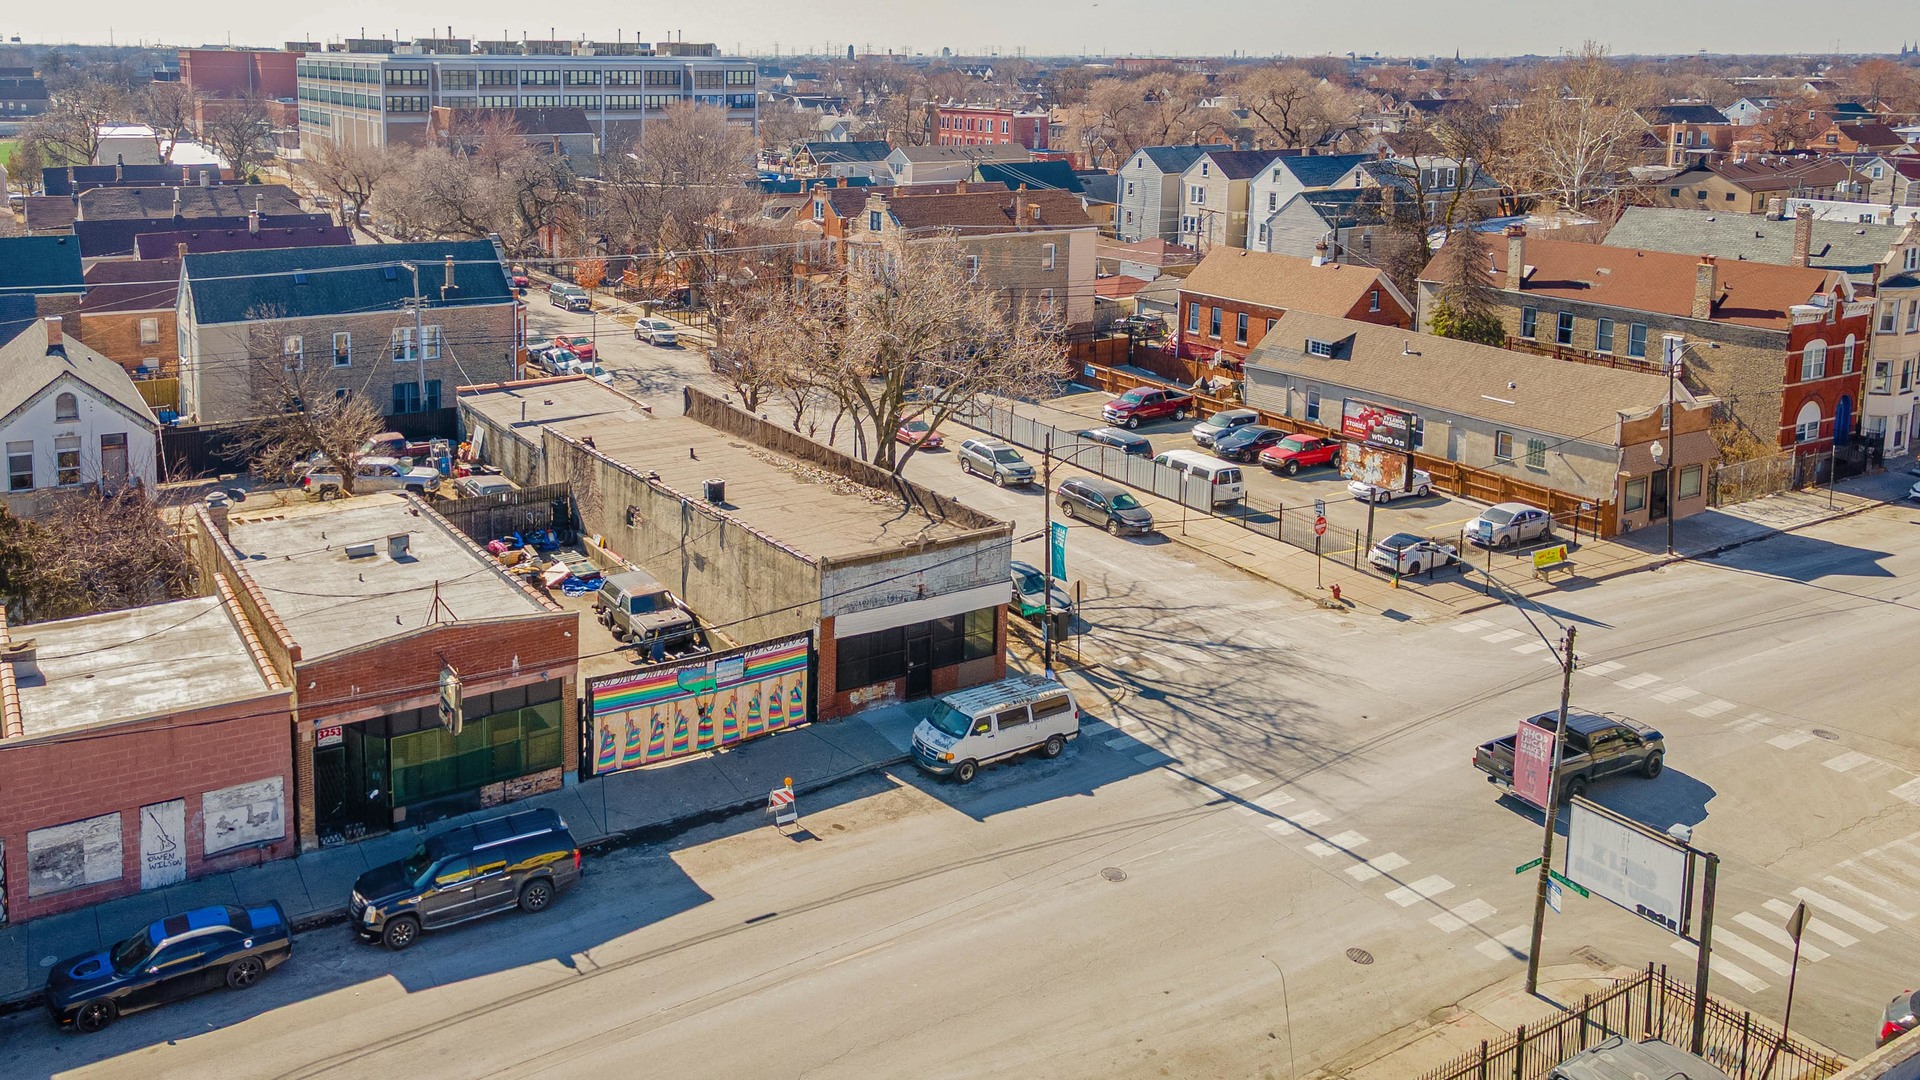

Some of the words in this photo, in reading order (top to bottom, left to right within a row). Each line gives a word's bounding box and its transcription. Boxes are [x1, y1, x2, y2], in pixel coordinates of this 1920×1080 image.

[319, 727, 341, 740] 3253
[1522, 728, 1548, 743] SHOP
[147, 853, 175, 862] OWEN
[149, 857, 182, 869] WILSON
